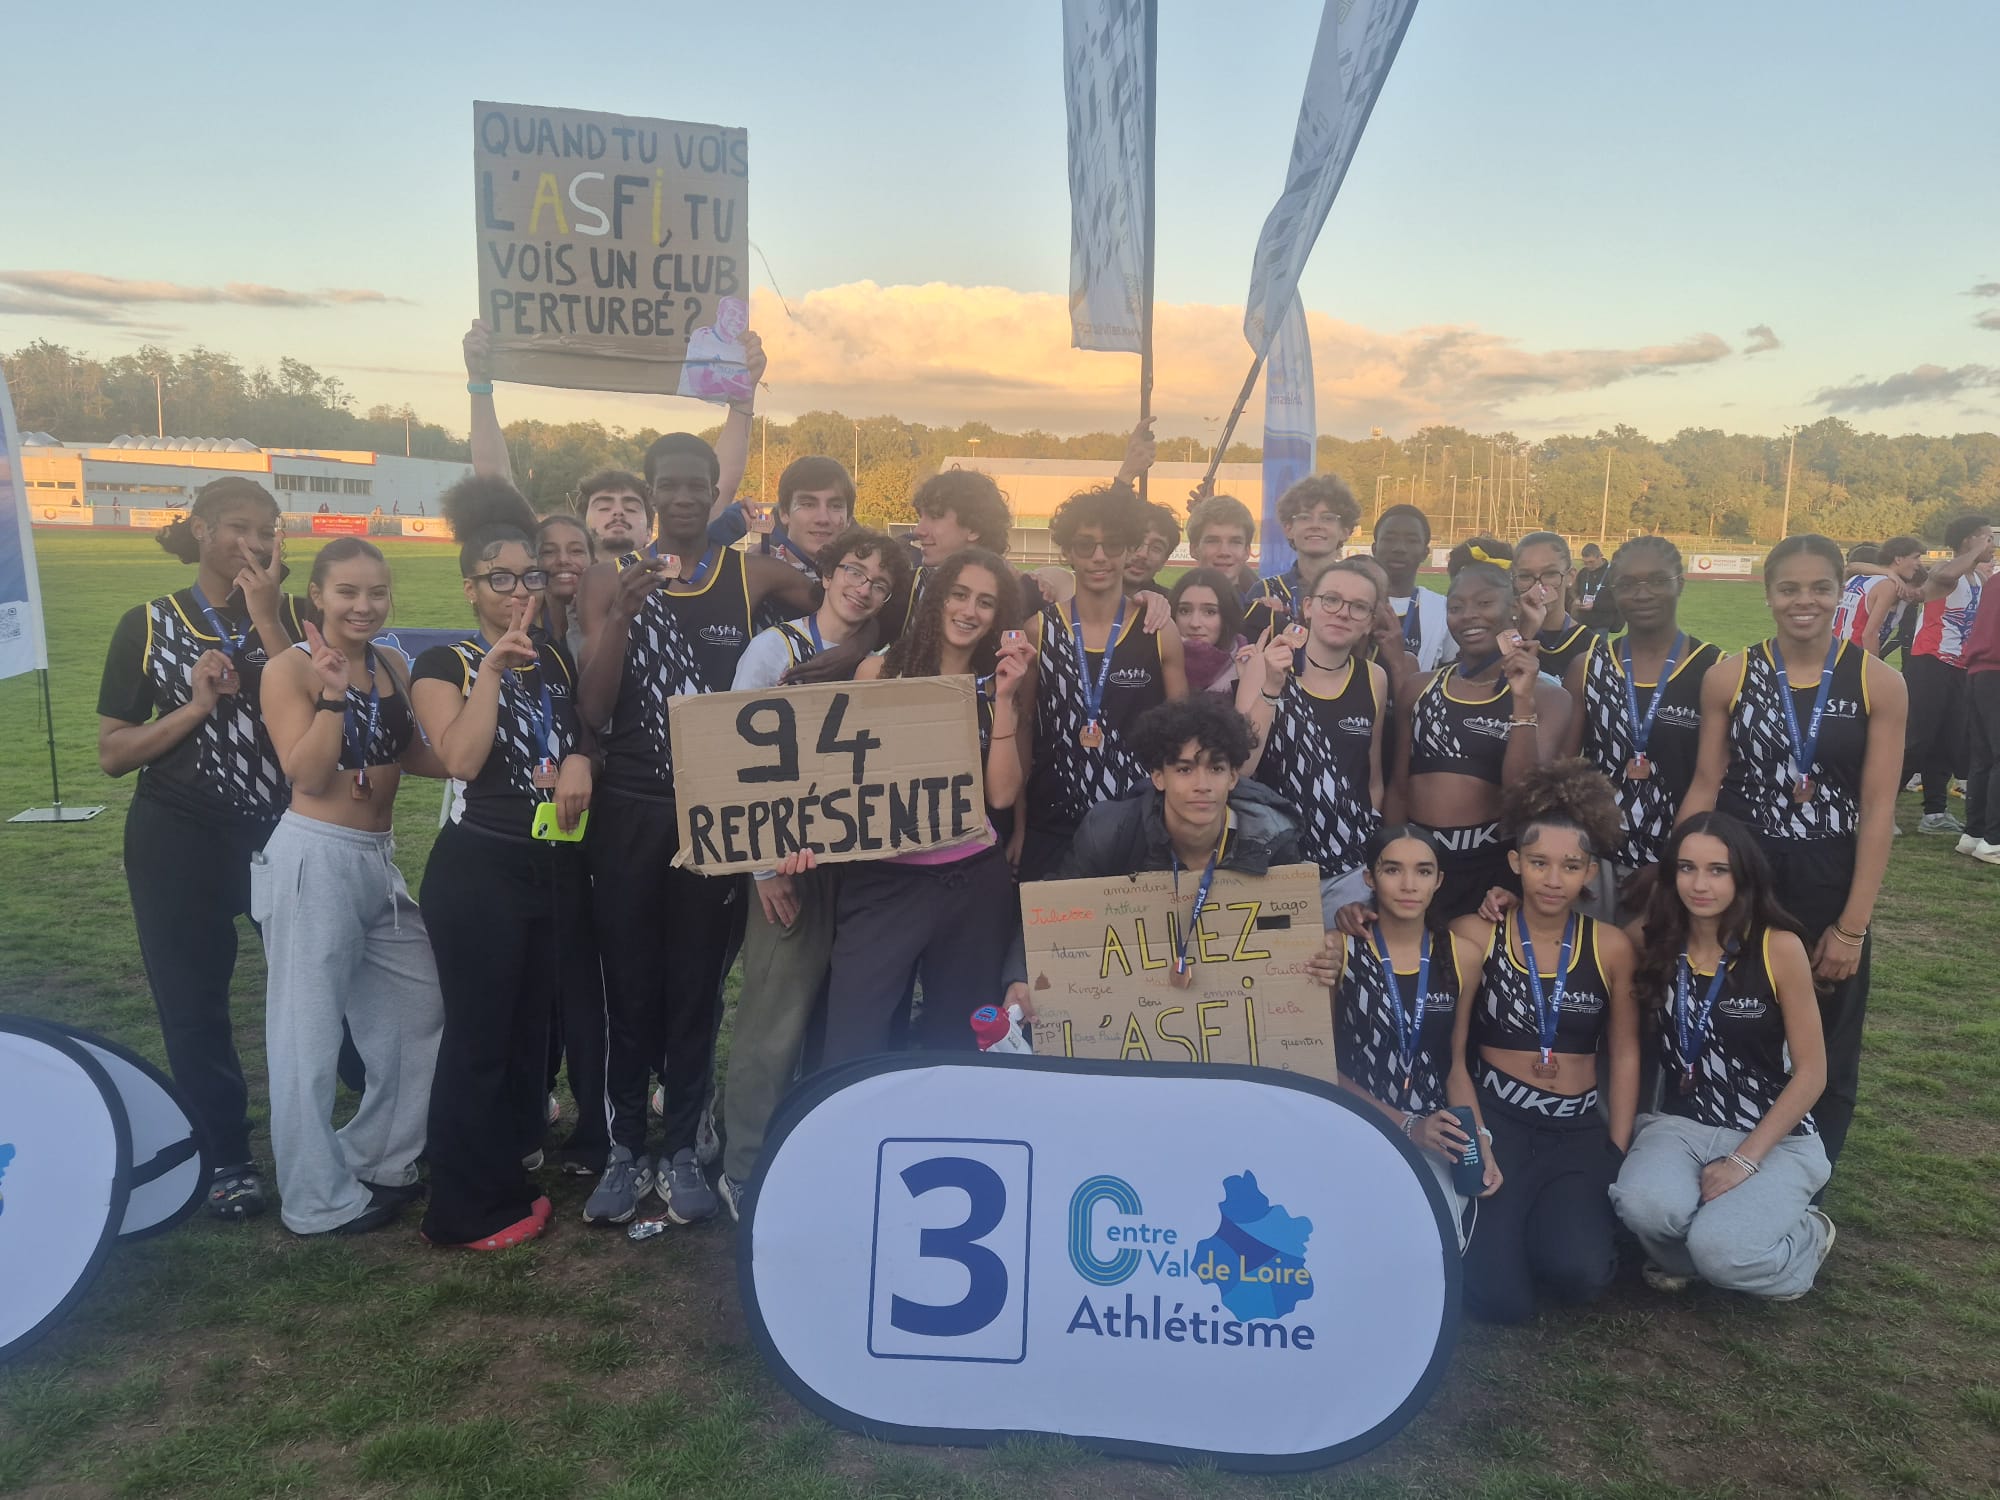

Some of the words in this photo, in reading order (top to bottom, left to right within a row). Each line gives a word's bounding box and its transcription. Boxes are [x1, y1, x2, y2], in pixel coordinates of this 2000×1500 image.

[481, 111, 607, 160] QUAND
[612, 127, 658, 164] TU
[684, 193, 734, 243] TU
[590, 246, 637, 289] UN
[653, 253, 739, 296] CLUB
[735, 693, 881, 785] 94
[688, 771, 974, 865] REPRÉSENTE
[1028, 907, 1095, 926] Juliette
[1100, 900, 1272, 979] ALLEZ
[1051, 941, 1091, 960] Adam
[1483, 1070, 1582, 1117] NIKE
[890, 1156, 1009, 1337] 3
[1068, 1174, 1177, 1287] Centre
[1147, 1249, 1188, 1278] Val
[1197, 1250, 1230, 1281] de
[1239, 1254, 1310, 1285] Loire
[1066, 1293, 1315, 1350] Athlétisme
